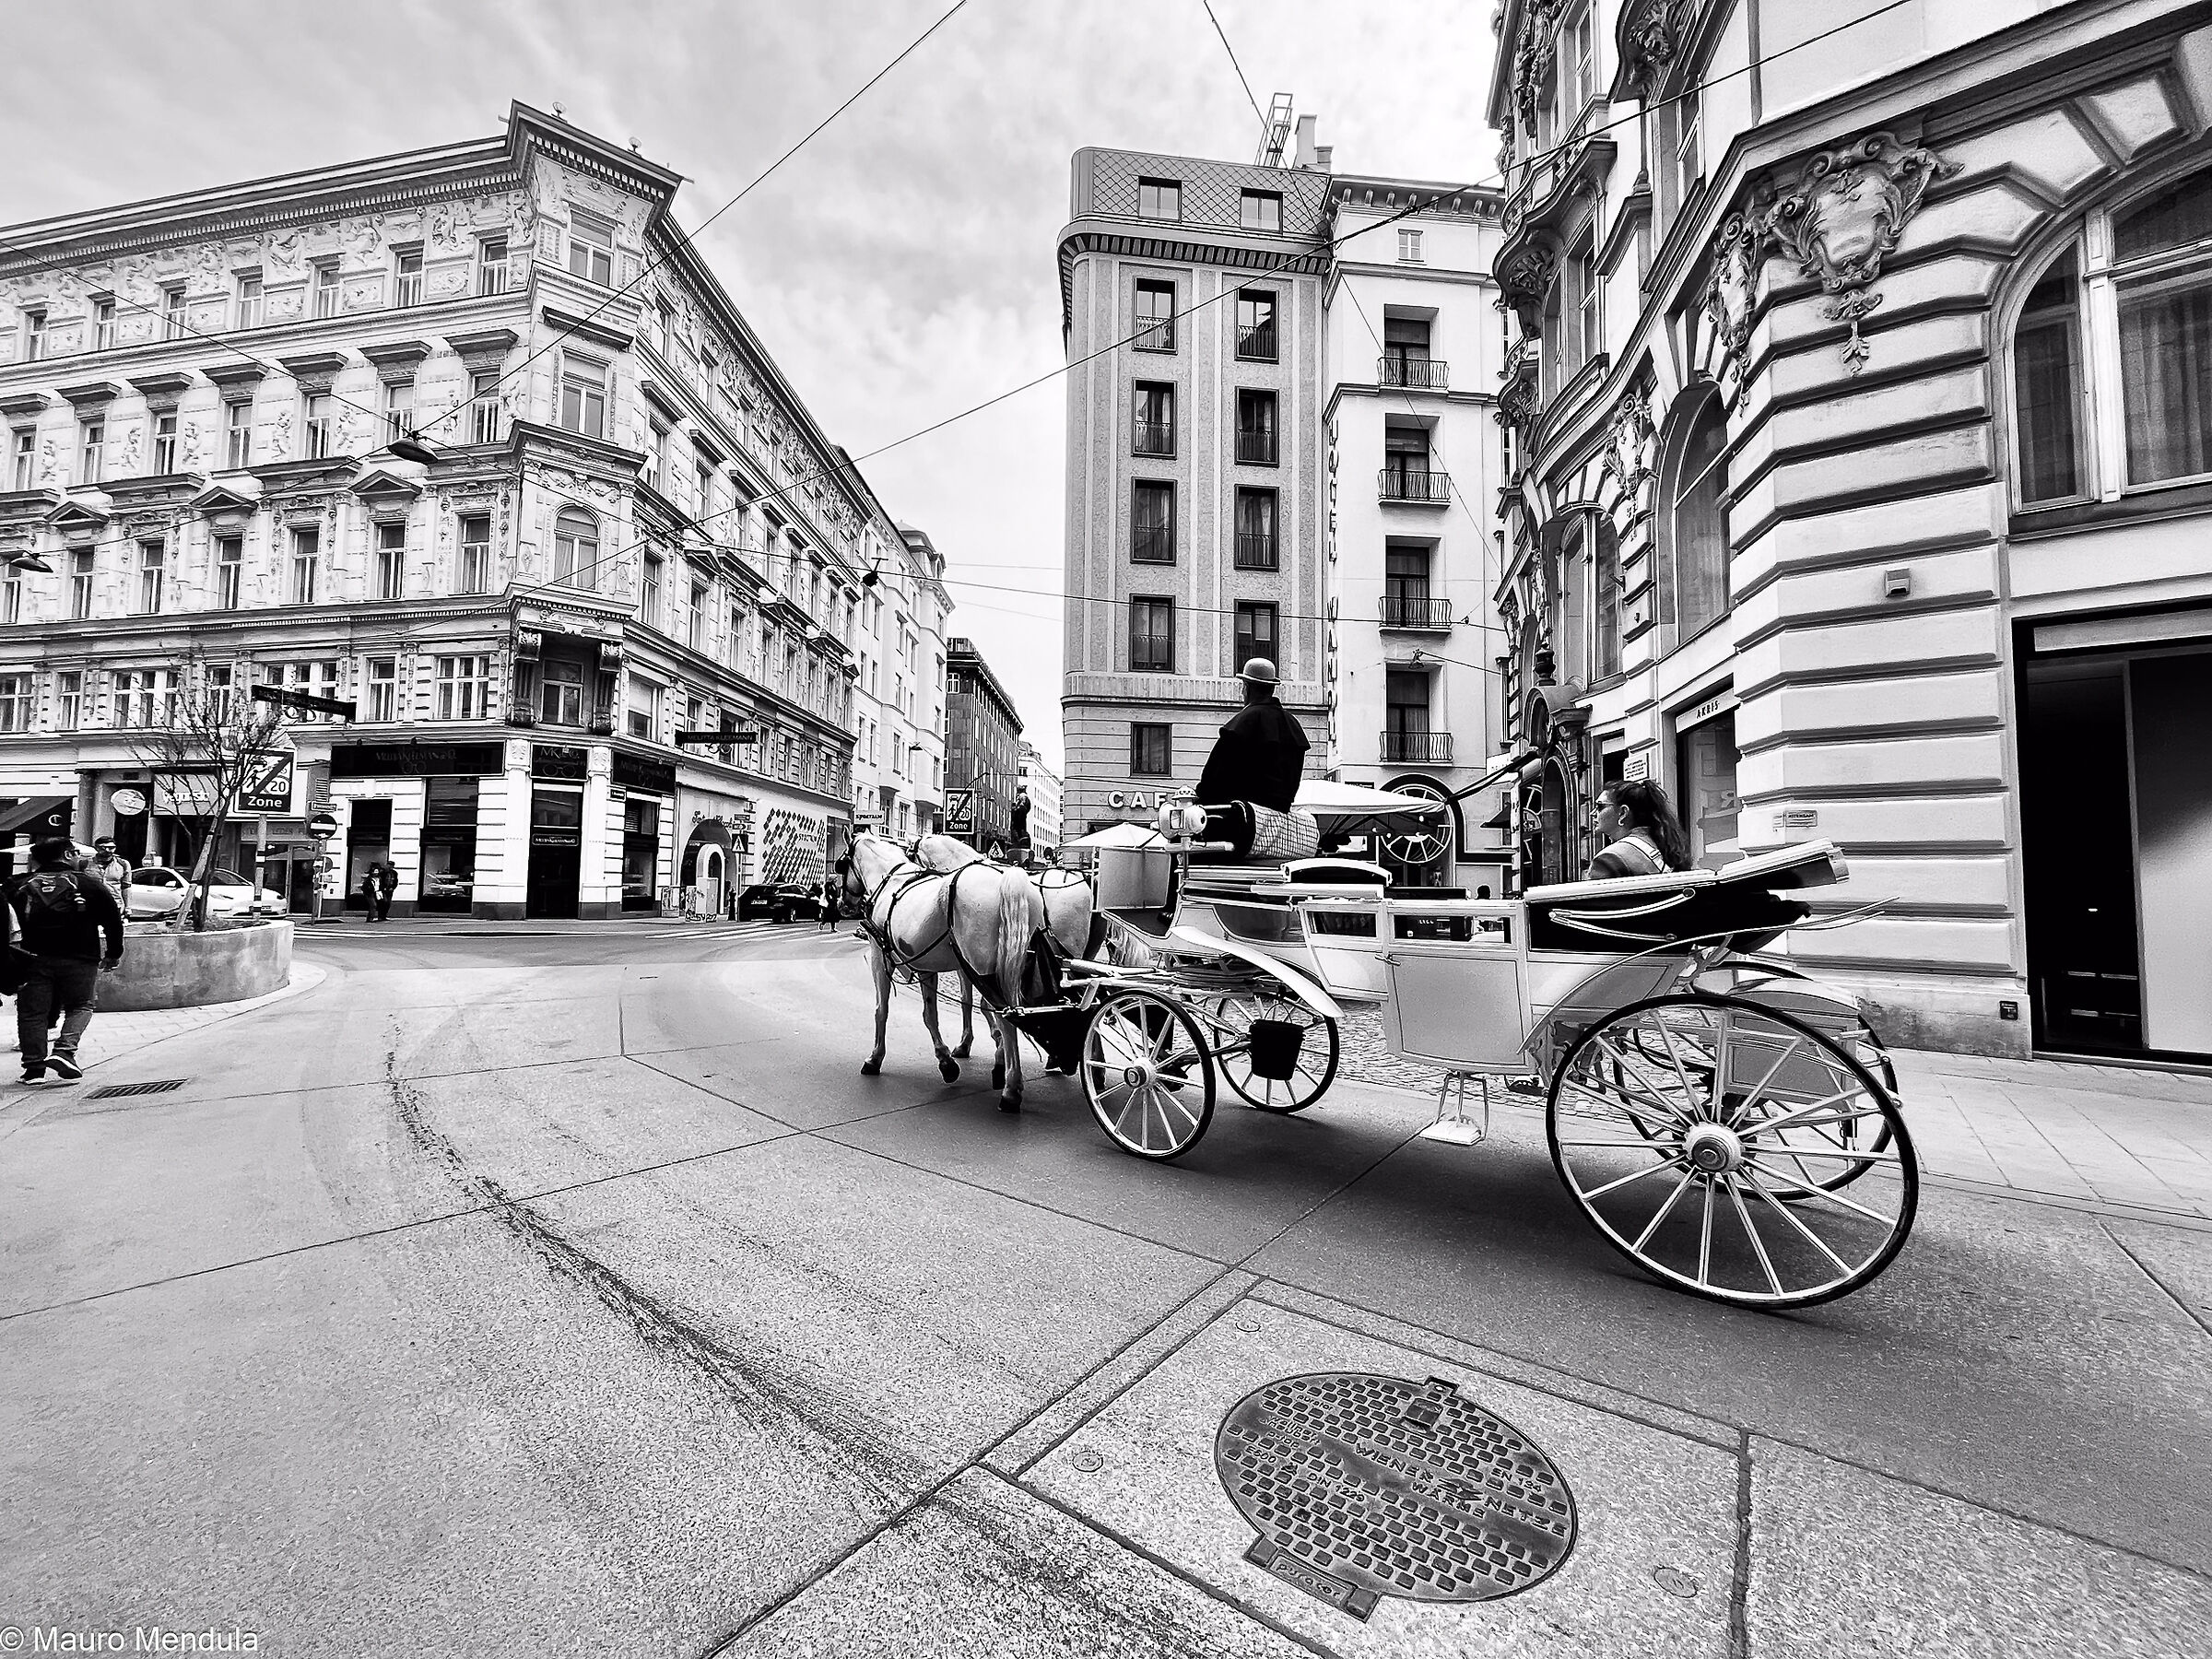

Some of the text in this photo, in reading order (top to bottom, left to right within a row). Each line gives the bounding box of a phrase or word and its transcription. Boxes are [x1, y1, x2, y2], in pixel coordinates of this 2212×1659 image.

[1696, 700, 1719, 719] AKRIS
[270, 781, 286, 793] 20
[248, 795, 283, 808] Zone
[1108, 790, 1168, 808] CAF
[949, 821, 968, 830] Zone
[1296, 1394, 1335, 1412] purator
[1491, 1466, 1513, 1482] EN
[1306, 1472, 1365, 1502] DIN 1229
[1355, 1442, 1568, 1538] WIENER NETZE
